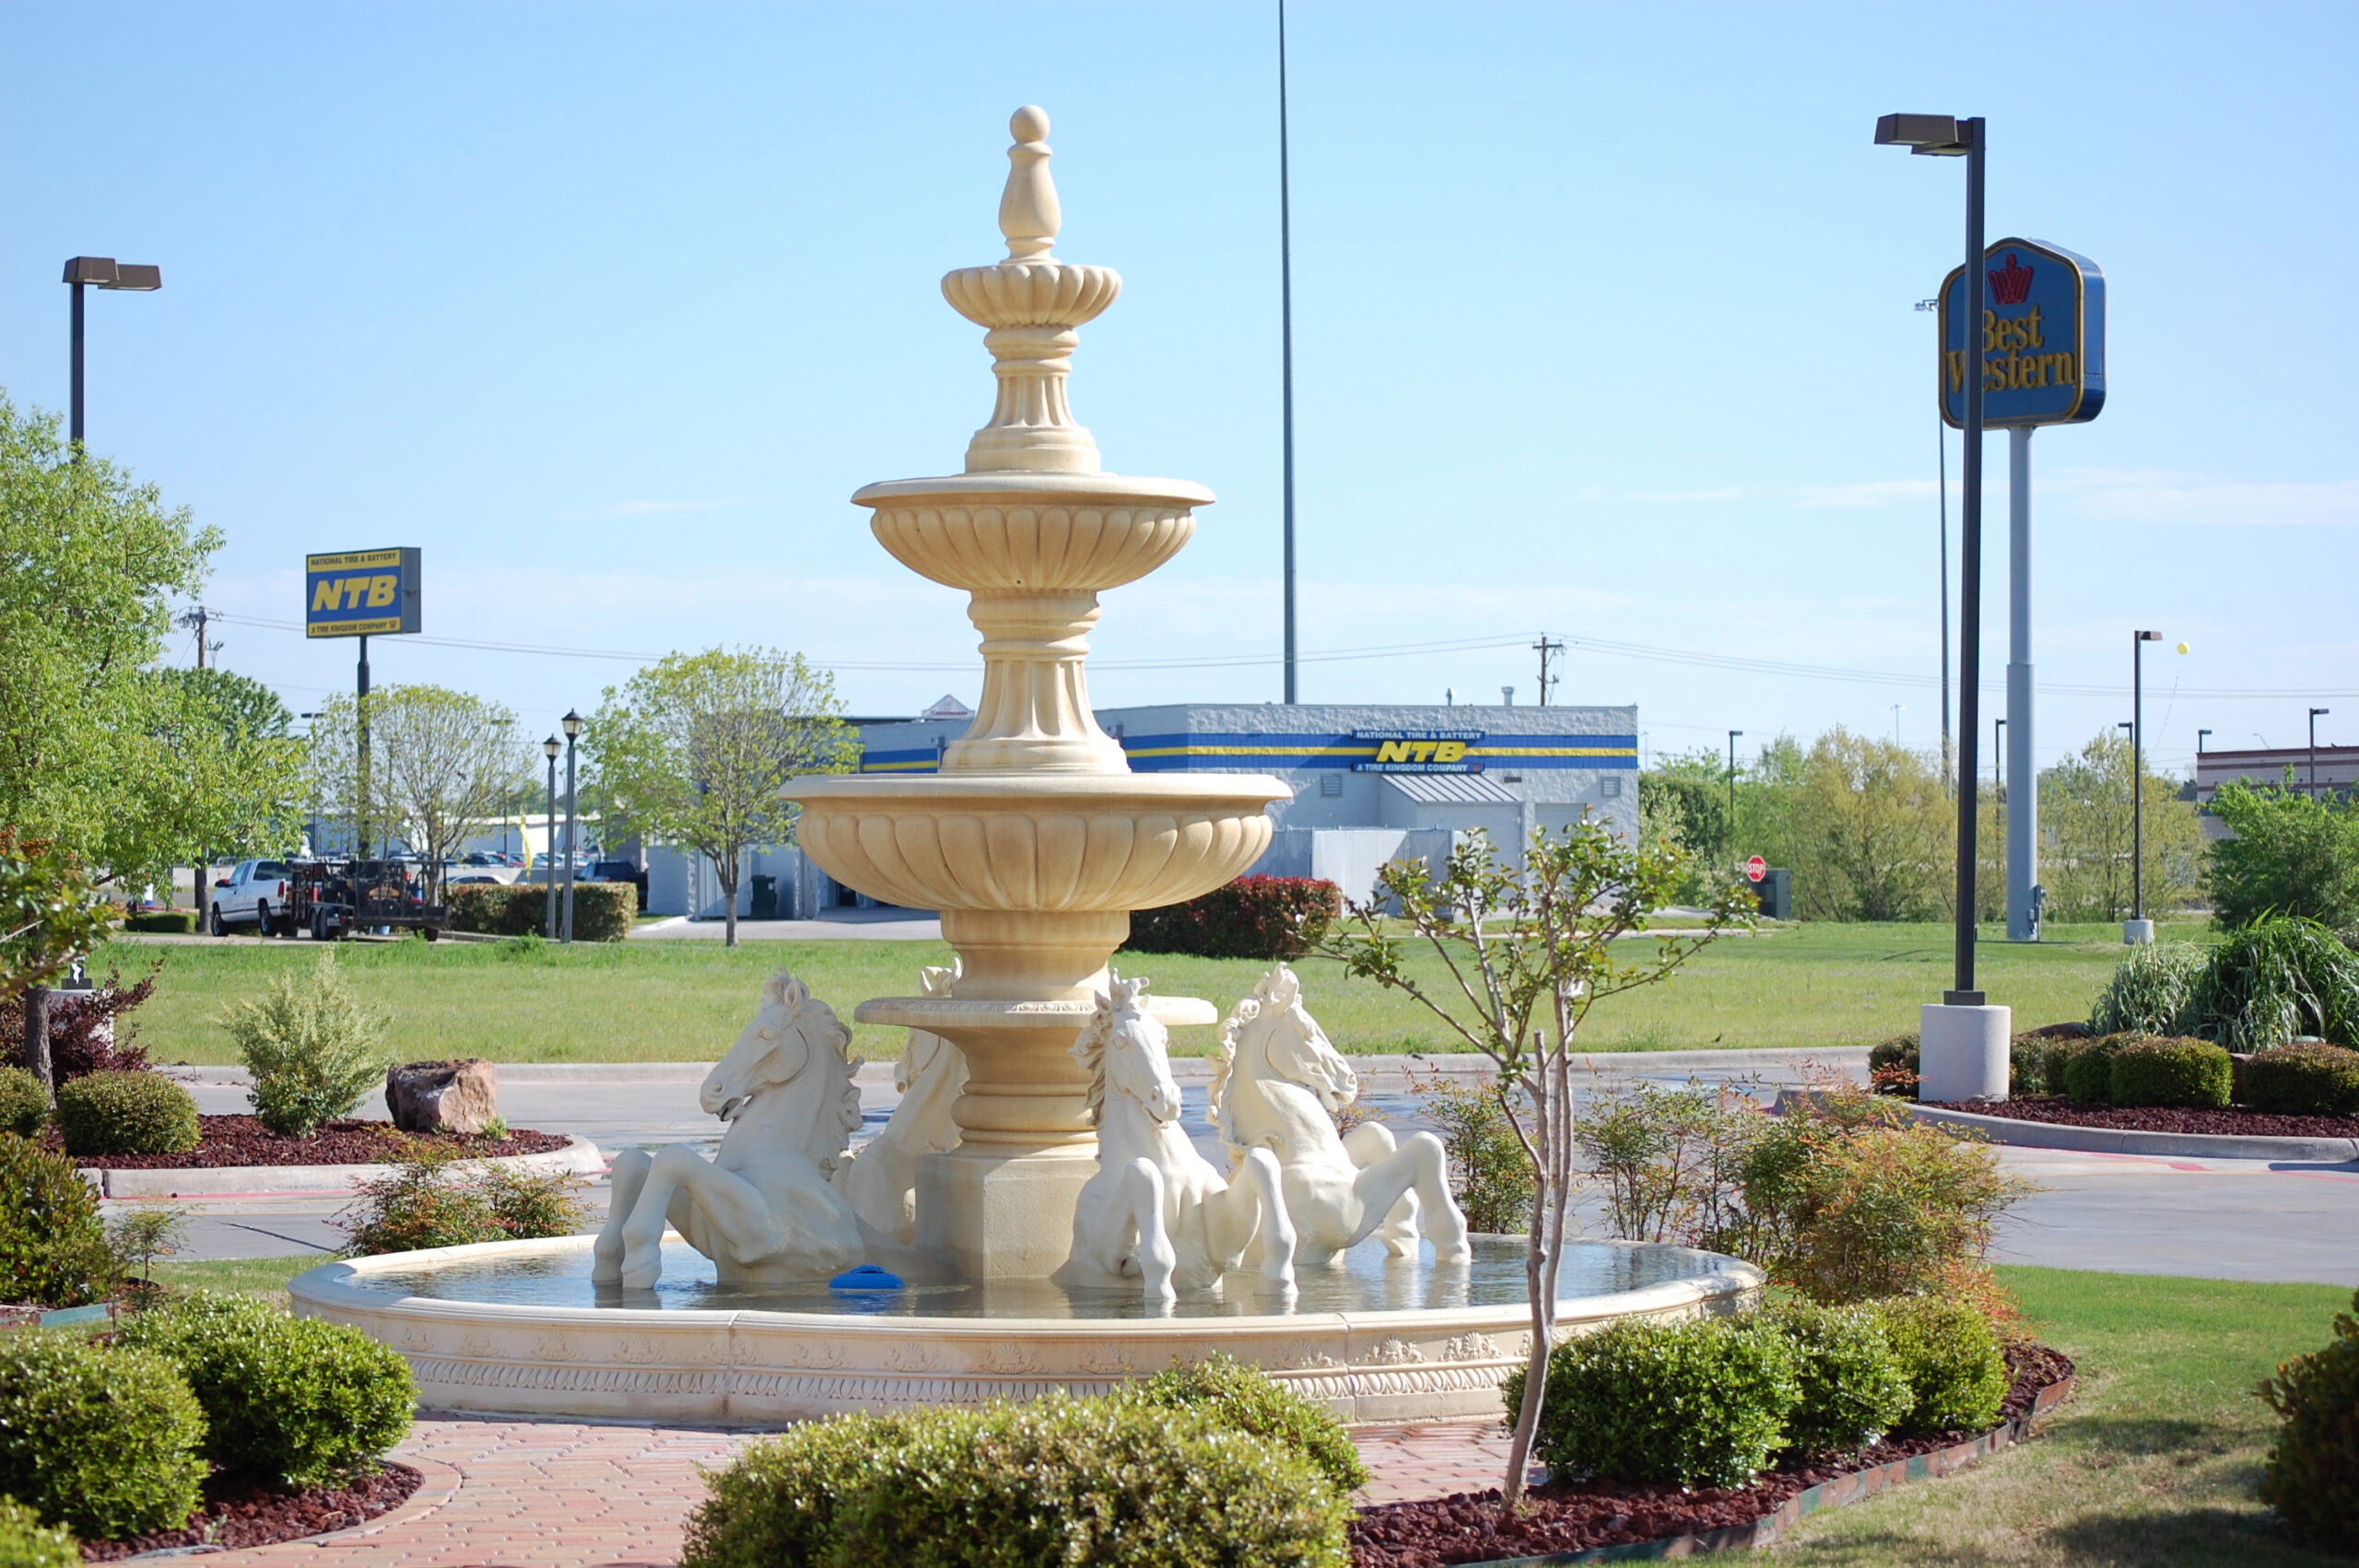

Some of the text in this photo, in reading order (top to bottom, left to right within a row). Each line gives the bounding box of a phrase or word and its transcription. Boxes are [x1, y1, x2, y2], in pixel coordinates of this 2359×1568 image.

[1983, 305, 2045, 352] Best
[311, 557, 343, 566] NATIONAL
[368, 553, 396, 561] BATTERY
[311, 575, 397, 612] NTB
[1376, 741, 1466, 763] NTB
[1356, 764, 1468, 772] A TIRE KINGDOM COMPANY
[1748, 863, 1764, 874] STOP
